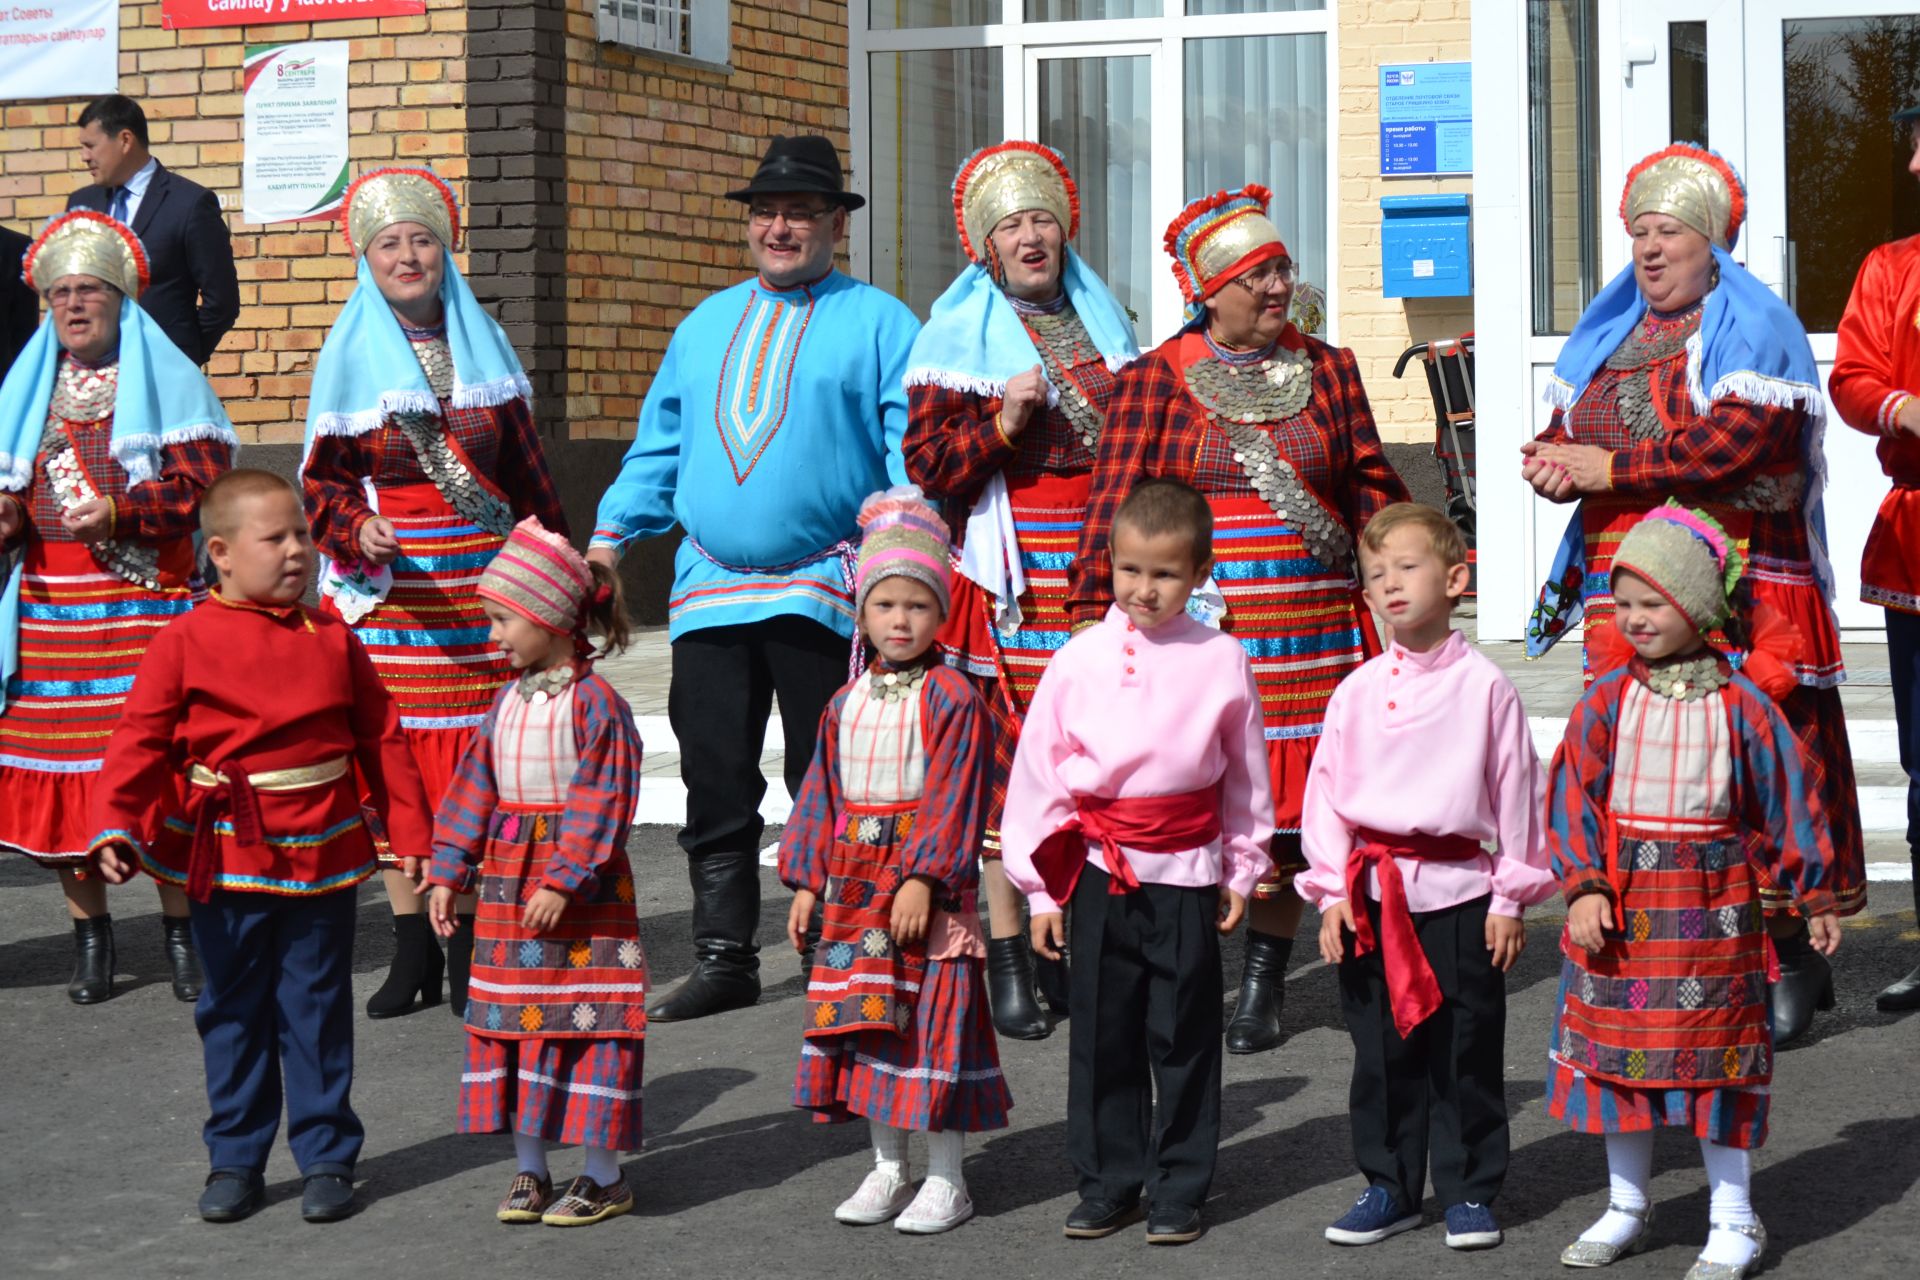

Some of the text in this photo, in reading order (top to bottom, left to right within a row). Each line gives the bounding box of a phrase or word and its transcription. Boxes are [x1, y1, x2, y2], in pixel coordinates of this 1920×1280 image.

[12, 7, 53, 20] Советы
[277, 64, 315, 77] 8 СЕНТЯБРЯ
[302, 98, 337, 107] ЗАЯВЛЕНИЙ
[1386, 238, 1461, 260] ПОЧТА
